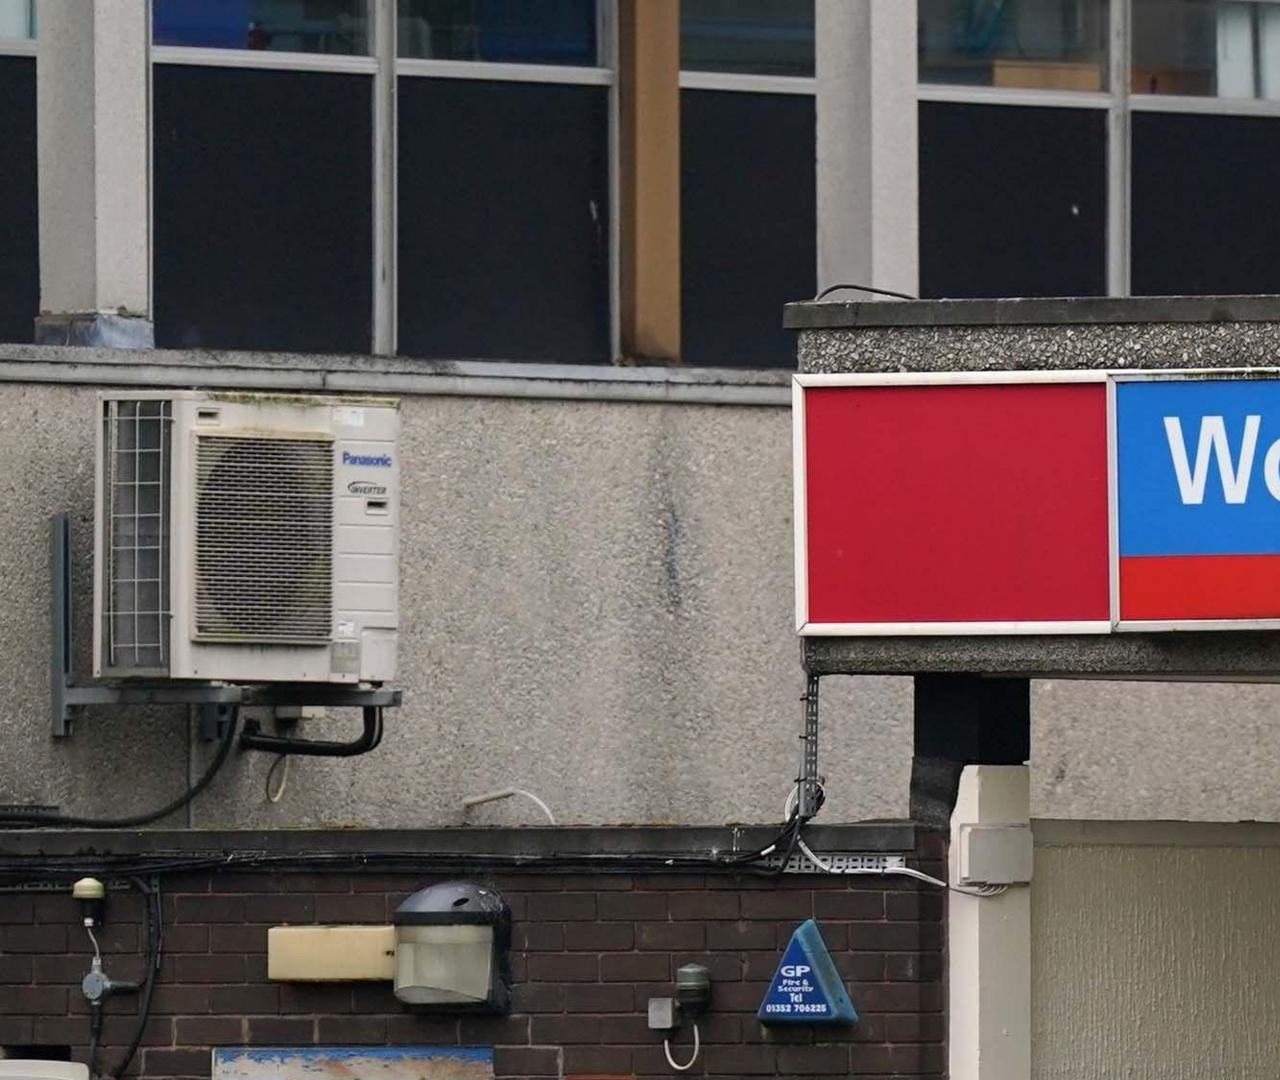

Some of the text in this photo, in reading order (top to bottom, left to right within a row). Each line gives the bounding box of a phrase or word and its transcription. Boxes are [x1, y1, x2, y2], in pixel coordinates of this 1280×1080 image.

[342, 451, 392, 467] Panasonic
[351, 487, 387, 495] INVERTER
[780, 965, 811, 977] GP
[788, 993, 803, 1003] Tel
[765, 1004, 827, 1013] 01352 706225
